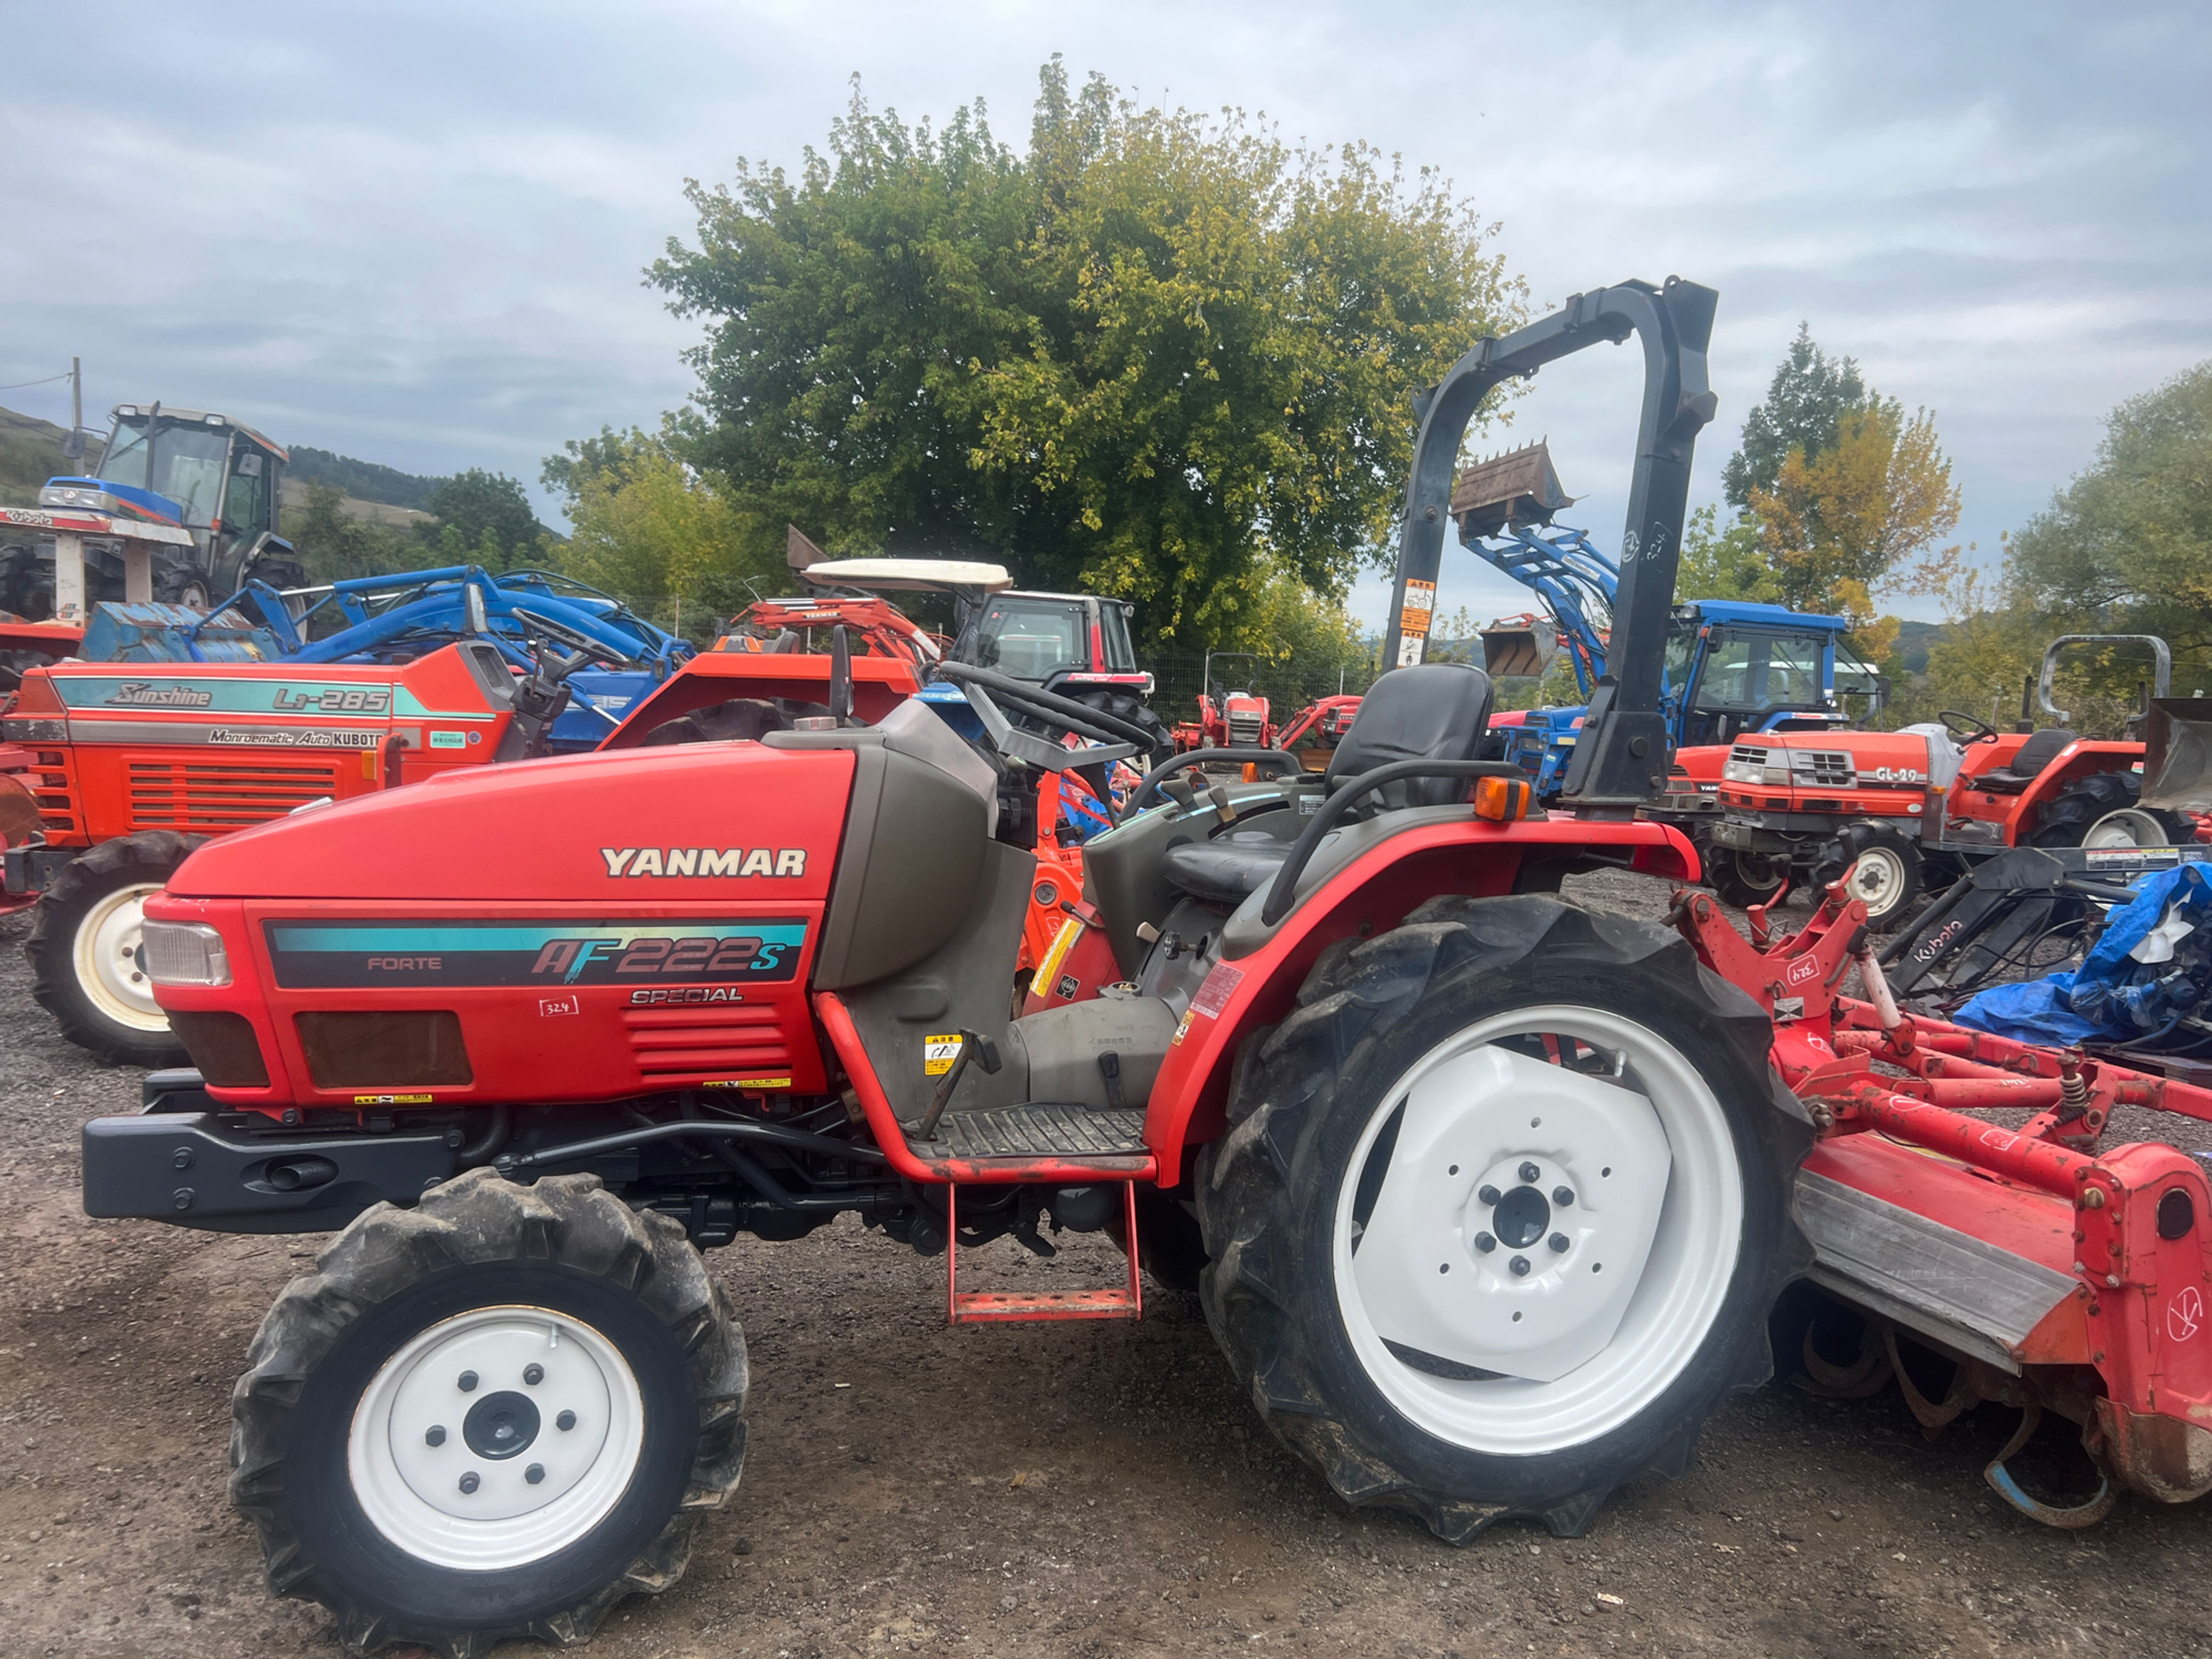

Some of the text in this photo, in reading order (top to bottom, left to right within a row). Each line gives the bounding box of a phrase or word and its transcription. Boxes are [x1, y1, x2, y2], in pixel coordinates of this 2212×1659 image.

[6, 510, 52, 525] Kubota
[104, 682, 213, 707] Sunshine
[209, 729, 294, 744] Monroematic
[296, 732, 331, 746] Auto
[1875, 766, 1917, 782] GL-29
[600, 847, 808, 878] YANMAR
[1913, 920, 1963, 963] Kubota
[368, 957, 442, 970] FORTE
[630, 987, 744, 1005] SPECIAL
[546, 1002, 570, 1015] 324
